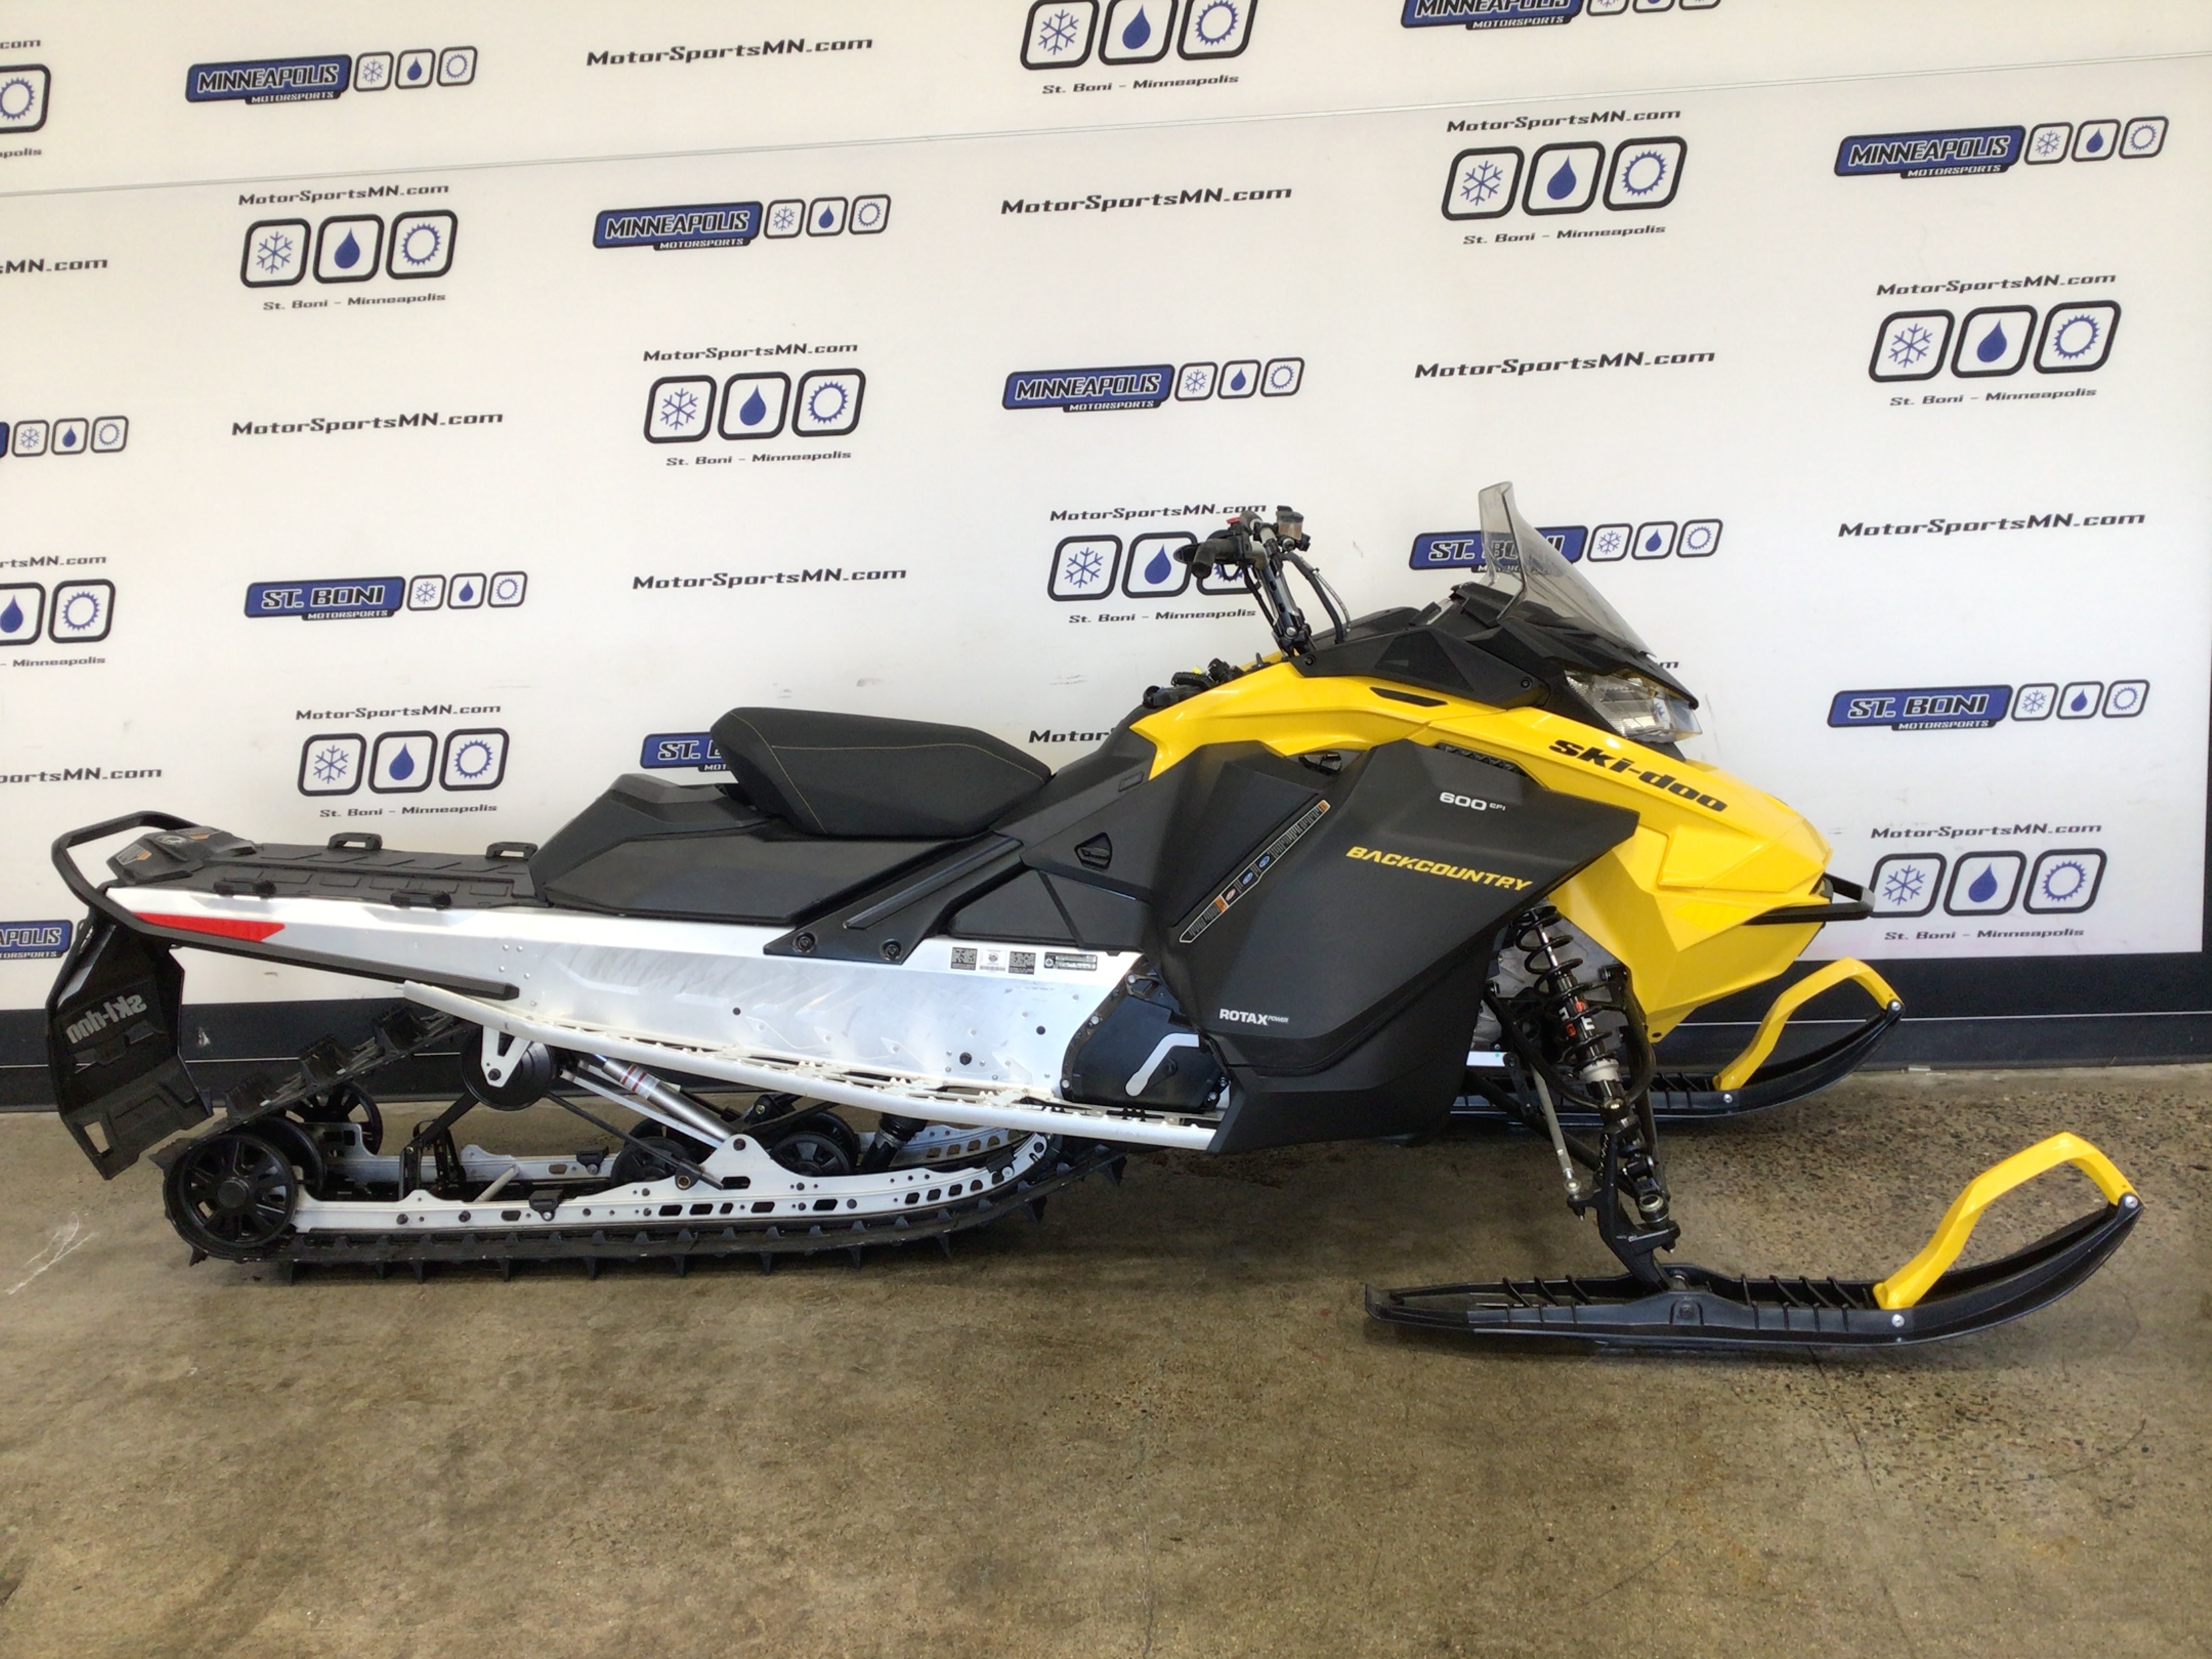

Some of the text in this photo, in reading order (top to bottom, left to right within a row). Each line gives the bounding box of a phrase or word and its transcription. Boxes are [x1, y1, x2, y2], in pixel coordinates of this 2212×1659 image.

[1473, 16, 1564, 28] MOTORSPORTS
[586, 38, 873, 66] MotorSportsMN.com
[197, 64, 338, 92] MINNEAPOLIS
[1042, 85, 1066, 94] St.
[1073, 83, 1112, 92] Boni
[1132, 75, 1239, 89] Minneapolis
[251, 91, 334, 103] MOTORSPORTS
[1446, 110, 1681, 133] MotorSportsMN.com
[1849, 136, 2011, 167] MINNEAPOLIS
[1907, 165, 2001, 177] MOTORSPORTS
[238, 184, 449, 206] MotorSportsMN.com
[1001, 187, 1292, 215] MotorSportsMN.com
[605, 211, 749, 238] MINNEAPOLIS
[660, 238, 743, 249] MOTORSPORTS
[1462, 235, 1488, 245] St.
[1494, 232, 1536, 243] Boni
[1557, 224, 1666, 239] Minneapolis
[1876, 274, 2116, 296] MotorSportsMN.com
[263, 302, 285, 310] St.
[291, 299, 328, 309] Boni
[347, 293, 446, 306] Minneapolis
[643, 343, 858, 362] MotorSportsMN.com
[1414, 351, 1715, 379] MotorSportsMN.com
[1015, 373, 1160, 400] MINNEAPOLIS
[1069, 401, 1154, 411] MOTORSPORTS
[1889, 396, 1915, 406] St.
[1922, 394, 1964, 405] Boni
[1985, 388, 2097, 401] Minneapolis
[232, 412, 503, 436] MotorSportsMN.com
[666, 457, 689, 466] St.
[695, 456, 733, 465] Boni
[752, 450, 851, 462] Minneapolis
[1838, 512, 2146, 537] MotorSportsMN.com
[1429, 539, 1475, 561] ST.
[632, 568, 907, 590] MotorSportsMN.com
[261, 586, 385, 609] ST. BONI
[308, 610, 388, 620] MOTORSPORTS
[1069, 615, 1092, 623] St.
[1098, 613, 1135, 622] Boni
[1155, 609, 1256, 620] Minneapolis
[12, 656, 106, 668] Minneapolis
[295, 704, 501, 720] MotorSportsMN.com
[1847, 694, 1989, 718] ST. BONI
[1898, 720, 1989, 731] MOTORSPORTS
[658, 740, 701, 760] ST.
[319, 809, 342, 818] St.
[347, 808, 383, 817] Boni
[401, 804, 497, 815] Minneapolis
[1439, 792, 1506, 811] 600 EFI
[1870, 823, 2102, 839] MotorSportsMN.com
[1346, 846, 1533, 890] BACKCOUNTRY
[1884, 932, 1909, 941] St.
[1915, 931, 1956, 940] Boni
[1977, 928, 2084, 939] Minneapolis
[1219, 1008, 1288, 1026] ROTAX POWER
